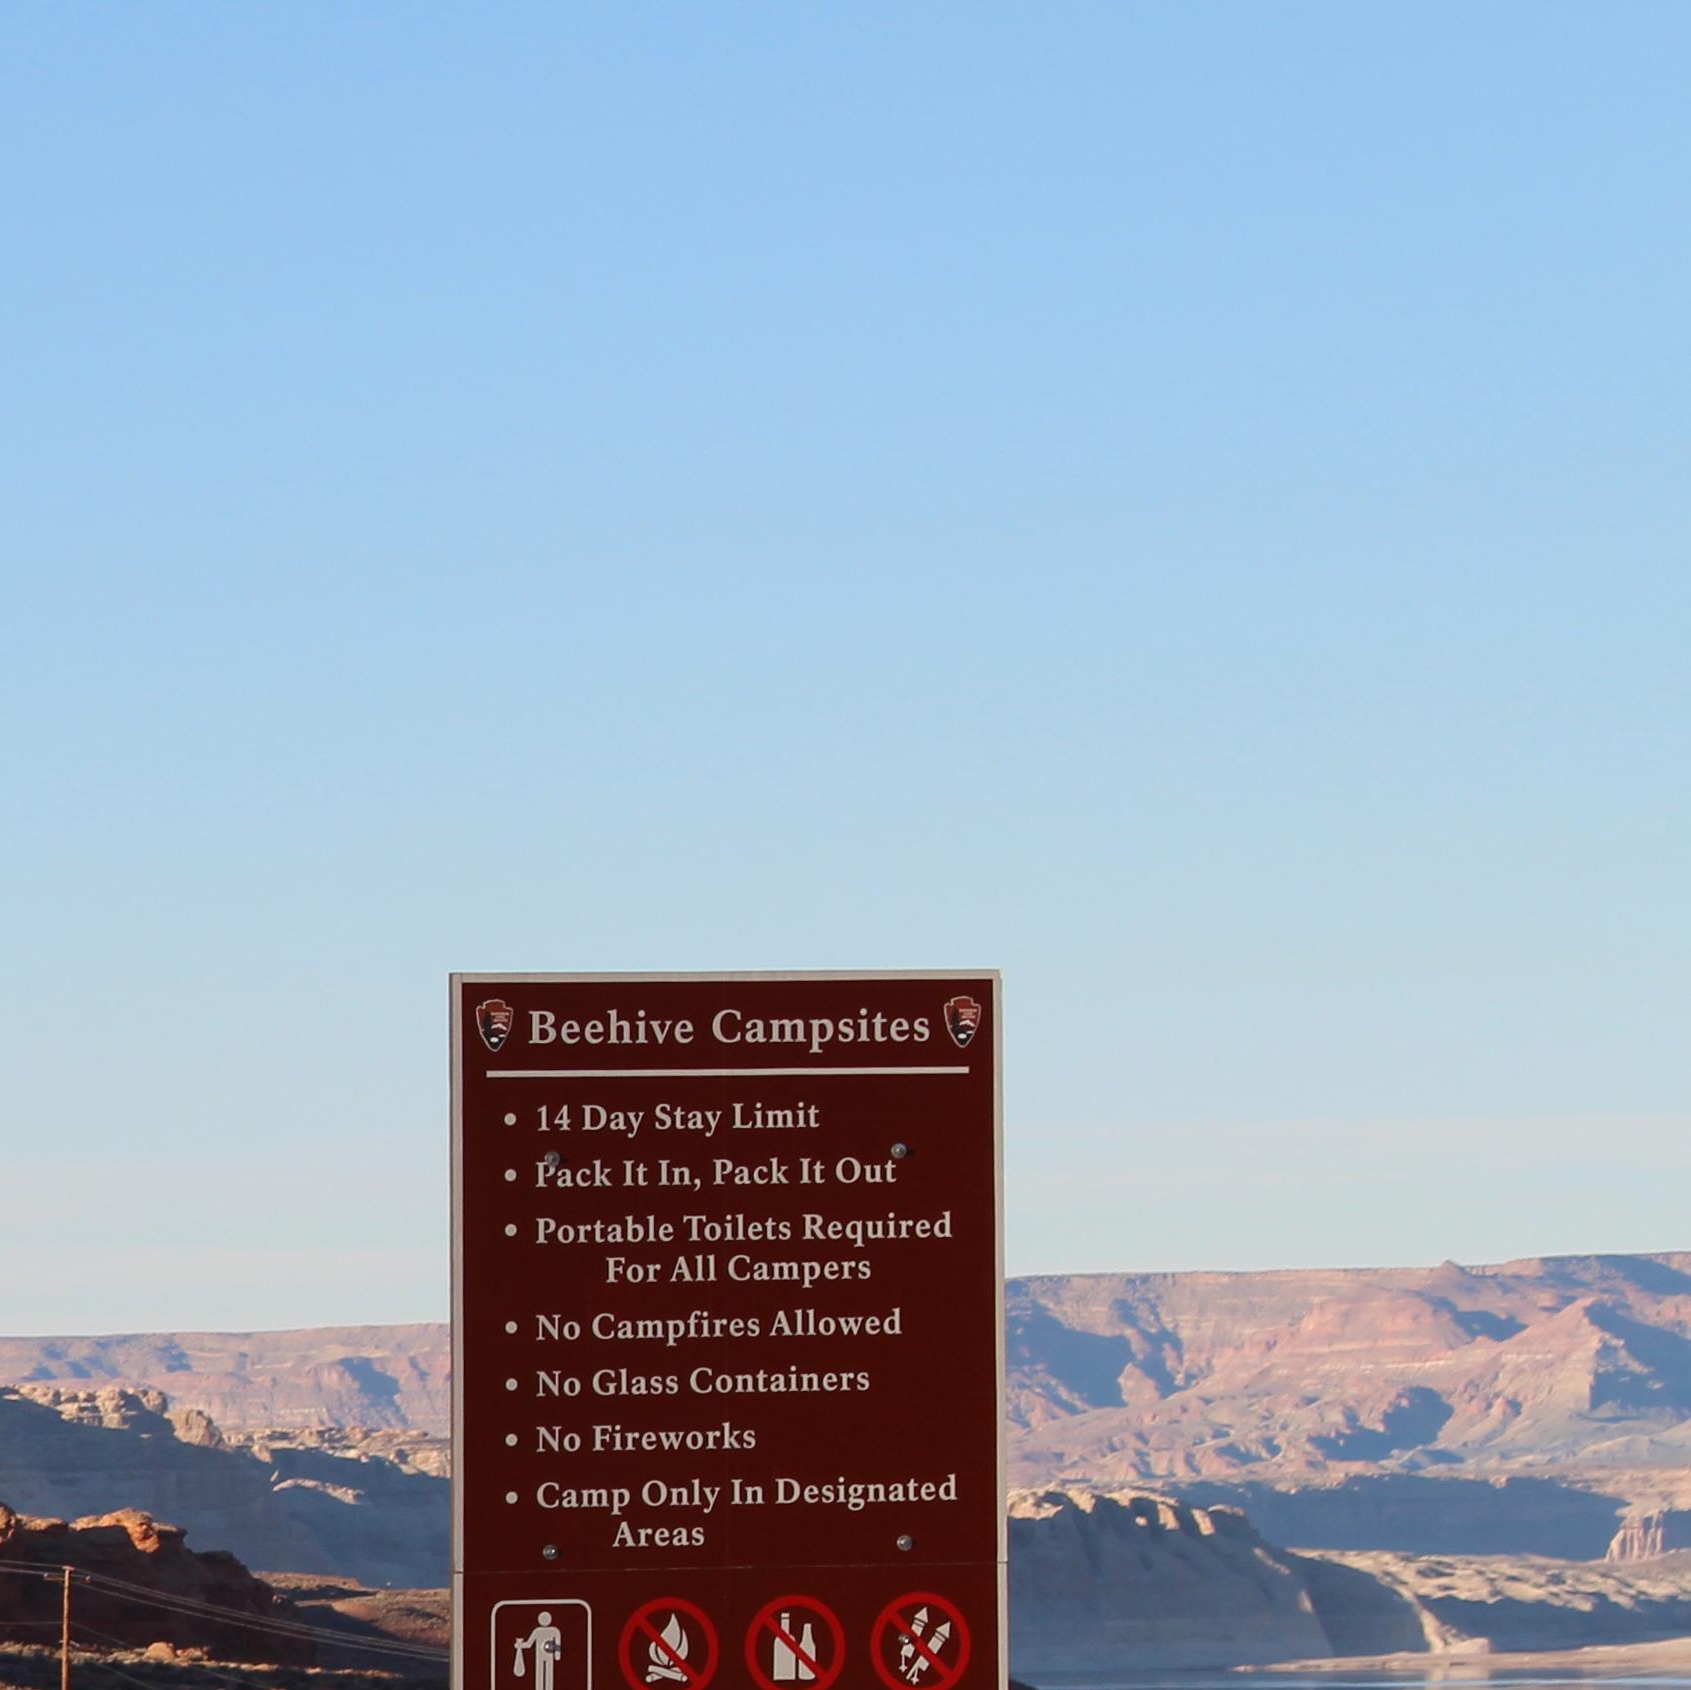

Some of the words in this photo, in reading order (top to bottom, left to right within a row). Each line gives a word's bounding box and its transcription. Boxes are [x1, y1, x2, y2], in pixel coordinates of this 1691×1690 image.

[528, 1010, 694, 1045] Beehive
[712, 1008, 930, 1054] Campsites
[537, 1104, 572, 1132] 14
[581, 1104, 645, 1139] Day
[654, 1103, 723, 1138] Stay
[732, 1101, 820, 1130] Limit
[535, 1159, 613, 1188] Pack
[622, 1159, 649, 1187] It
[658, 1159, 702, 1192] In,
[712, 1157, 789, 1186] Pack
[799, 1157, 826, 1184] It
[835, 1156, 897, 1184] Out
[535, 1214, 674, 1244] Portable
[682, 1213, 792, 1242] Toilets
[802, 1210, 953, 1248] Required
[605, 1256, 662, 1283] For
[669, 1254, 718, 1282] All
[727, 1254, 872, 1289] Campers
[535, 1314, 581, 1341] No
[591, 1308, 761, 1347] Campfires
[769, 1307, 902, 1337] Allowed
[536, 1370, 581, 1397] No
[592, 1367, 679, 1396] Glass
[689, 1366, 870, 1394] Containers
[536, 1425, 581, 1453] No
[592, 1421, 756, 1452] Fireworks
[536, 1481, 631, 1516] Camp
[641, 1478, 721, 1514] Only
[730, 1478, 765, 1506] In
[775, 1473, 958, 1512] Designated
[612, 1521, 705, 1548] Areas
